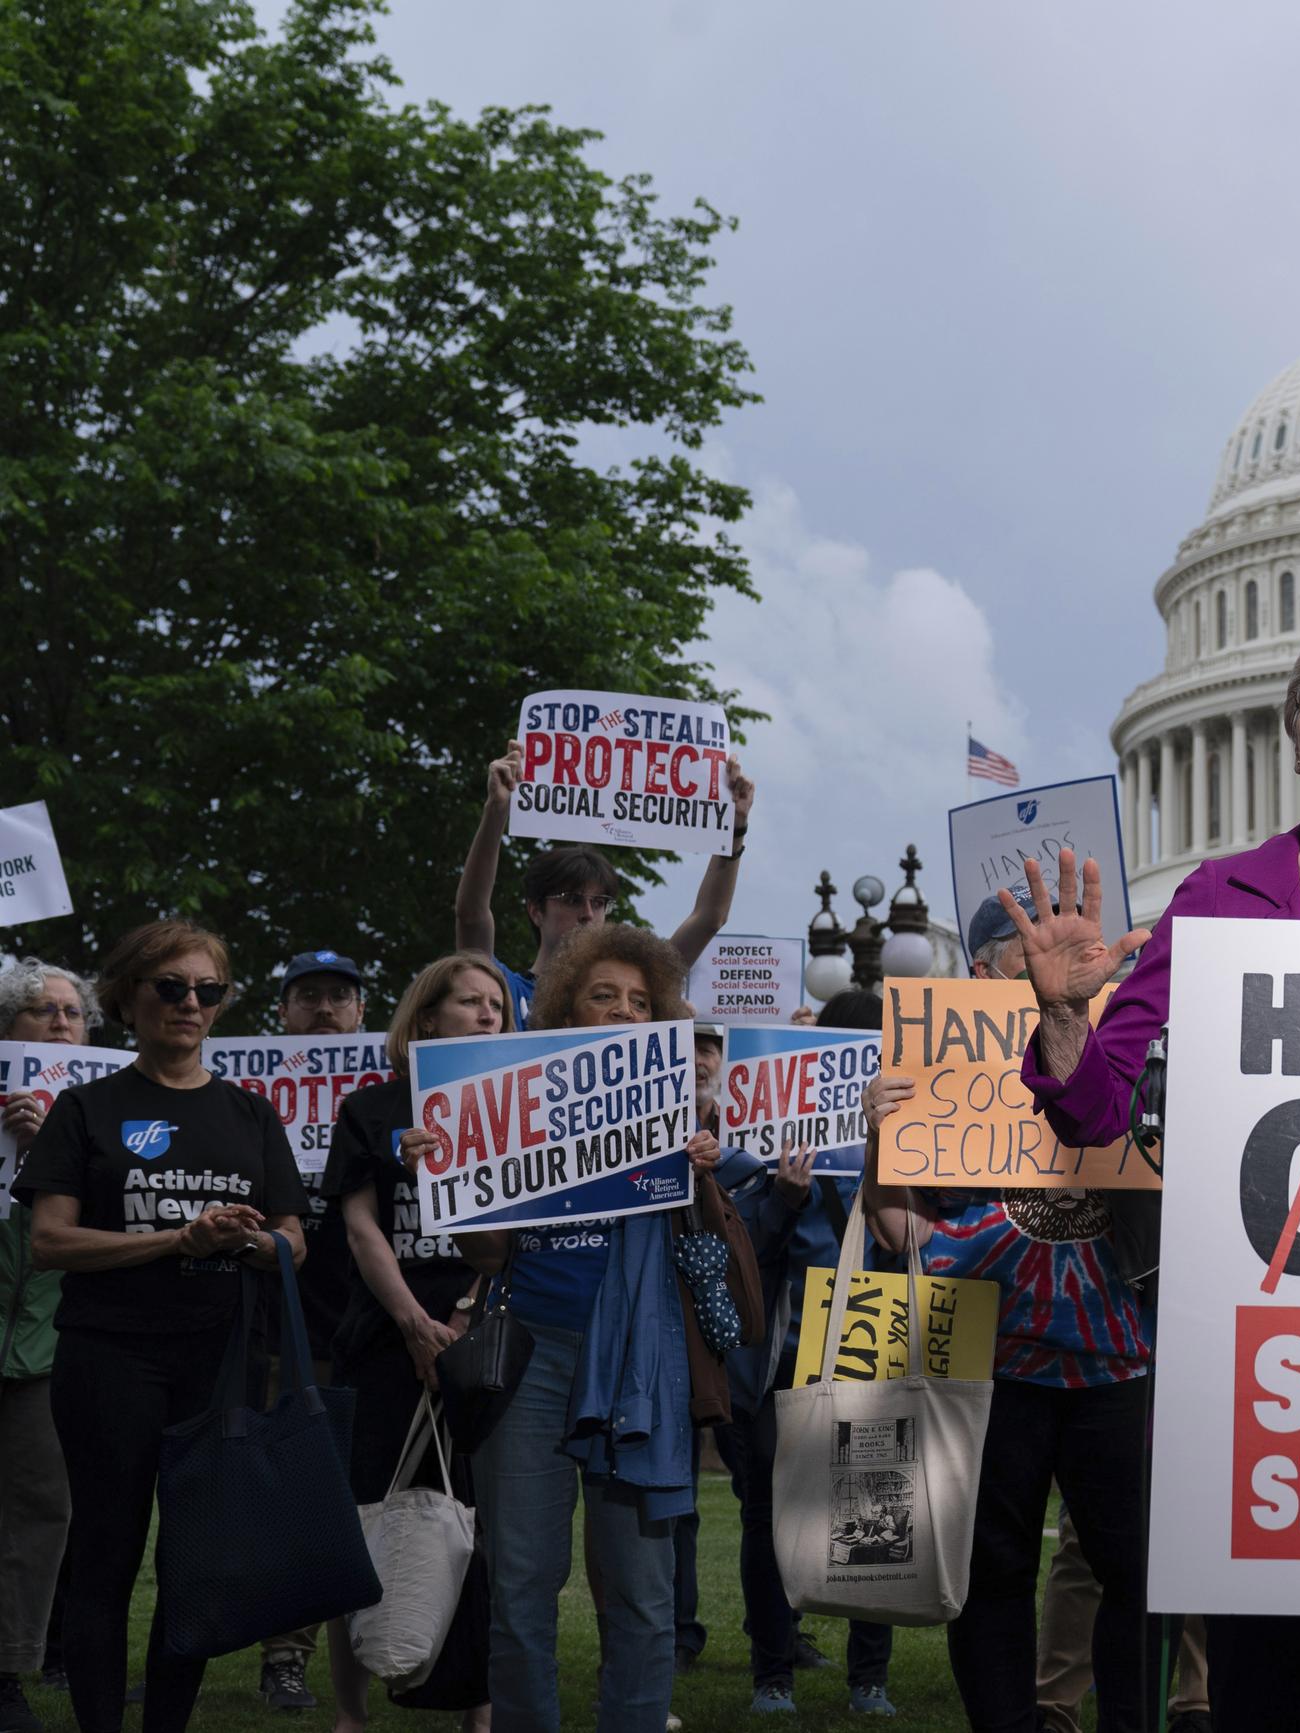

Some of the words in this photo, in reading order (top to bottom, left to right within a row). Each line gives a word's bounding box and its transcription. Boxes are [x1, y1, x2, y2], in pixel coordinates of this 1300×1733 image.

[526, 703, 600, 733] STOP
[597, 709, 625, 732] THE
[624, 708, 725, 749] STEAL!!
[524, 732, 728, 801] PROTECT
[517, 783, 605, 818] SOCIAL
[613, 792, 729, 831] SECURITY.
[0, 855, 36, 878] ORK
[712, 957, 739, 966] Social
[741, 957, 781, 966] Security
[719, 946, 773, 956] PROTECT
[712, 981, 739, 989] Social
[741, 981, 781, 990] Security
[720, 969, 772, 980] DEFEND
[712, 1006, 739, 1015] Social
[741, 1006, 781, 1016] Security
[717, 994, 775, 1006] EXPAND
[38, 1062, 69, 1085] THE
[211, 1050, 284, 1077] STOP
[281, 1050, 308, 1073] THE
[545, 1026, 687, 1103] SOCIAL
[549, 1069, 689, 1142] SECURITY.
[726, 1052, 819, 1128] SAVE
[928, 1069, 1034, 1118] SOC
[422, 1063, 546, 1176] SAVE
[782, 1117, 829, 1150] OUR
[126, 1120, 180, 1155] aft
[893, 1120, 1135, 1177] SECURIY
[431, 1164, 495, 1221] IT'S
[501, 1145, 568, 1200] OUR
[575, 1105, 690, 1179] MONEY!
[123, 1168, 253, 1196] Activists
[123, 1192, 238, 1221] Nev
[549, 1231, 608, 1250] vote.
[927, 1283, 957, 1379] GREE!
